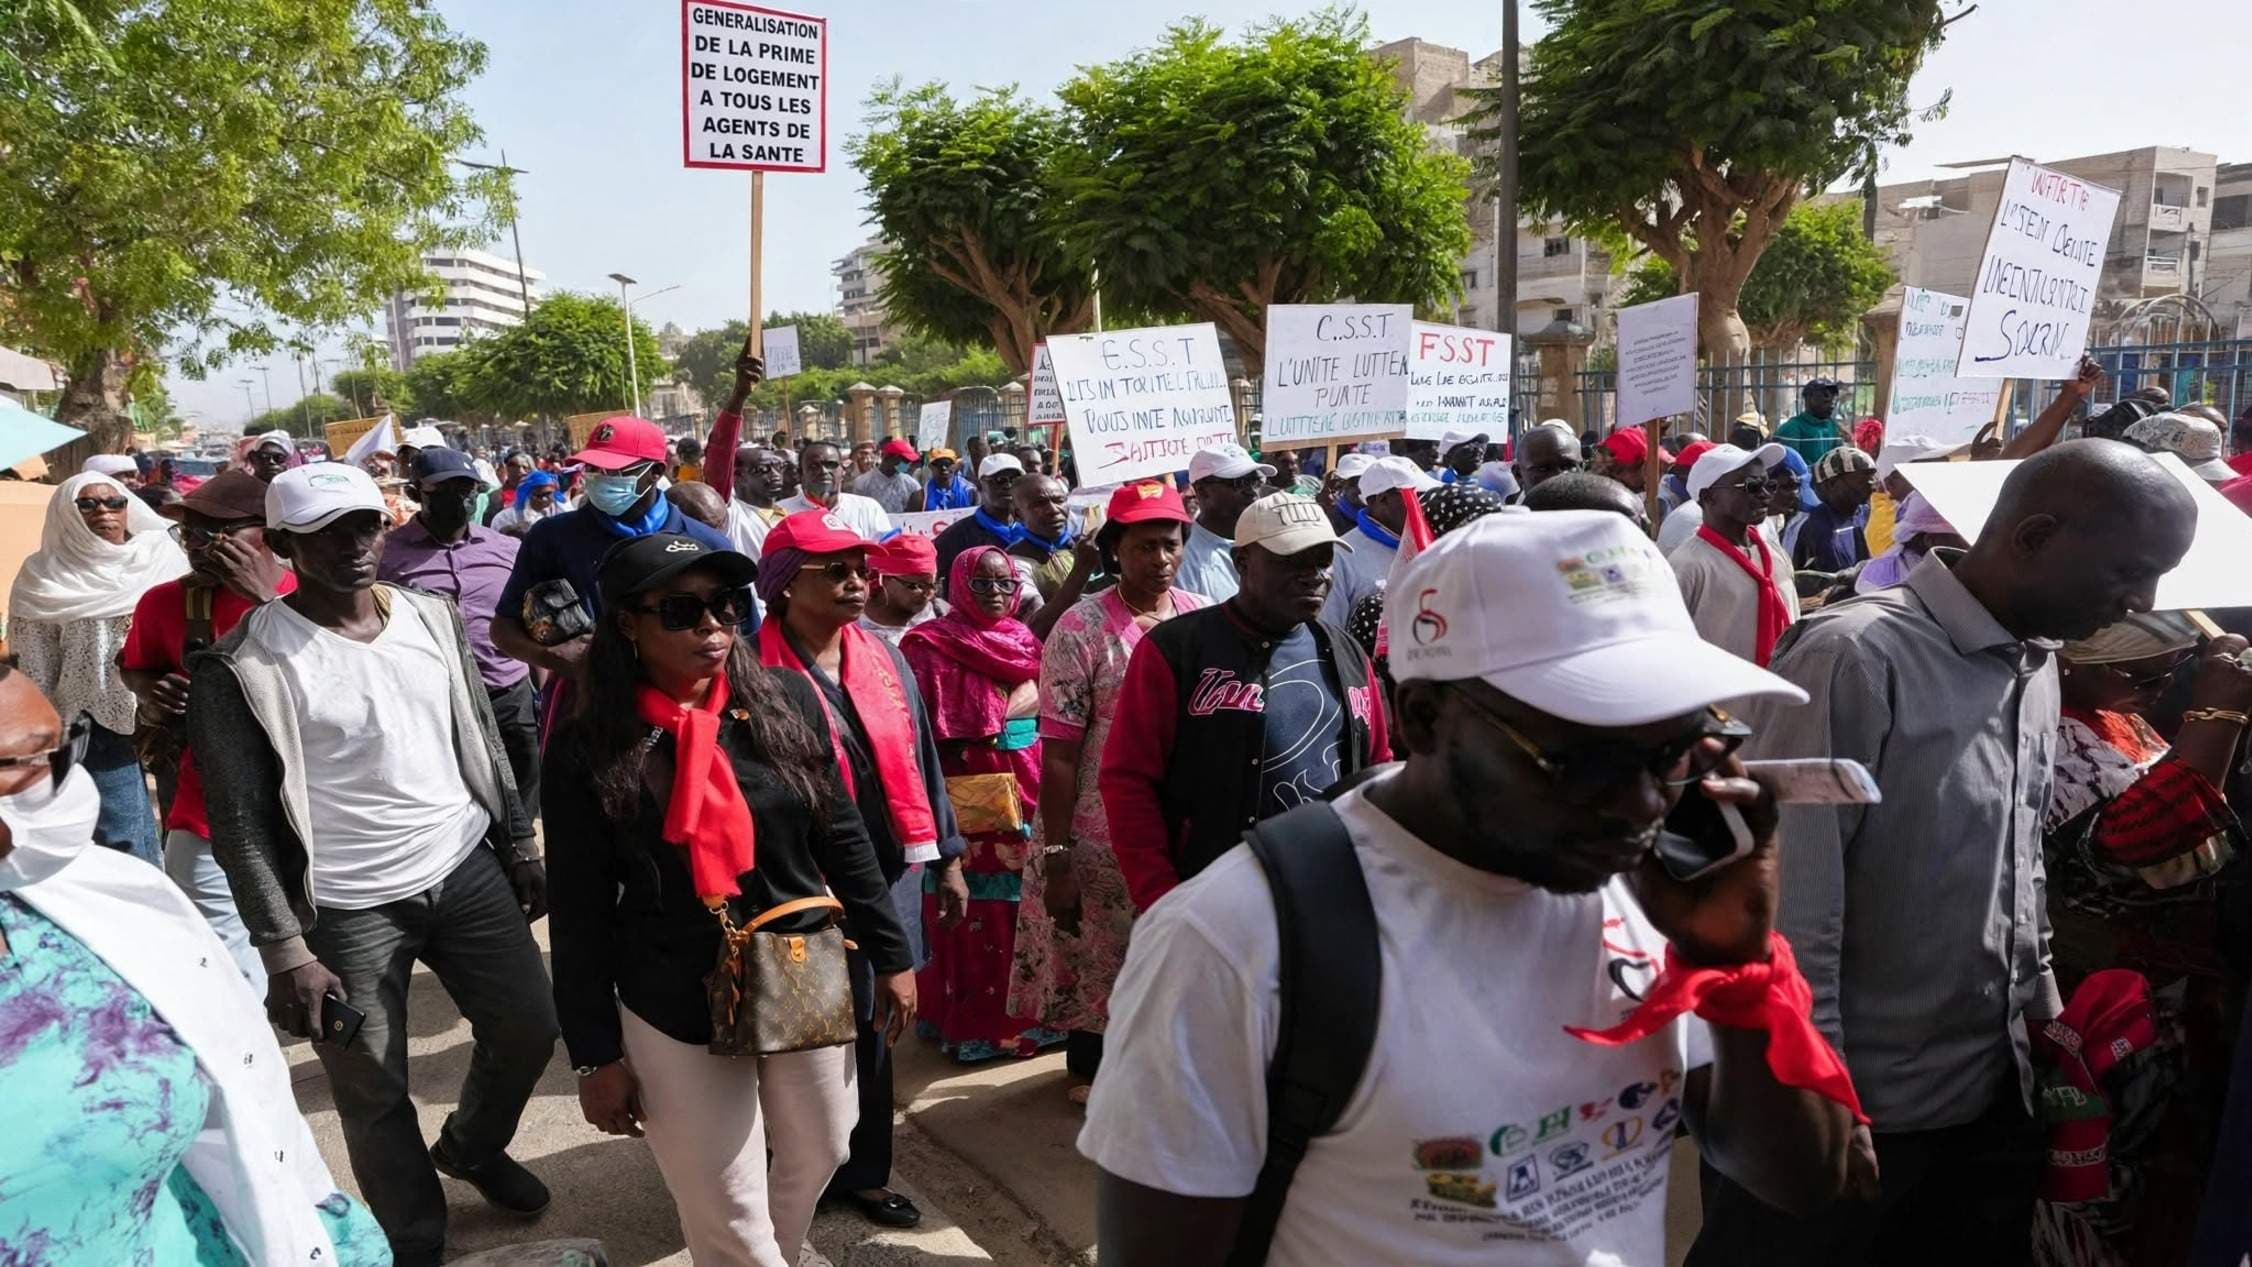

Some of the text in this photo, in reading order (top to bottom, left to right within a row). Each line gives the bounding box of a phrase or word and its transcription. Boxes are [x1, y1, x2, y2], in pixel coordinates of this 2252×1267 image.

[693, 7, 818, 40] GENERALISATION
[695, 35, 815, 64] DE LA PRIME
[691, 62, 819, 90] DE LOGEMENT
[700, 90, 811, 115] A TOUS LES
[703, 117, 810, 139] AGENTS DE
[710, 142, 804, 163] LA SANTE
[1419, 332, 1495, 367] FSST
